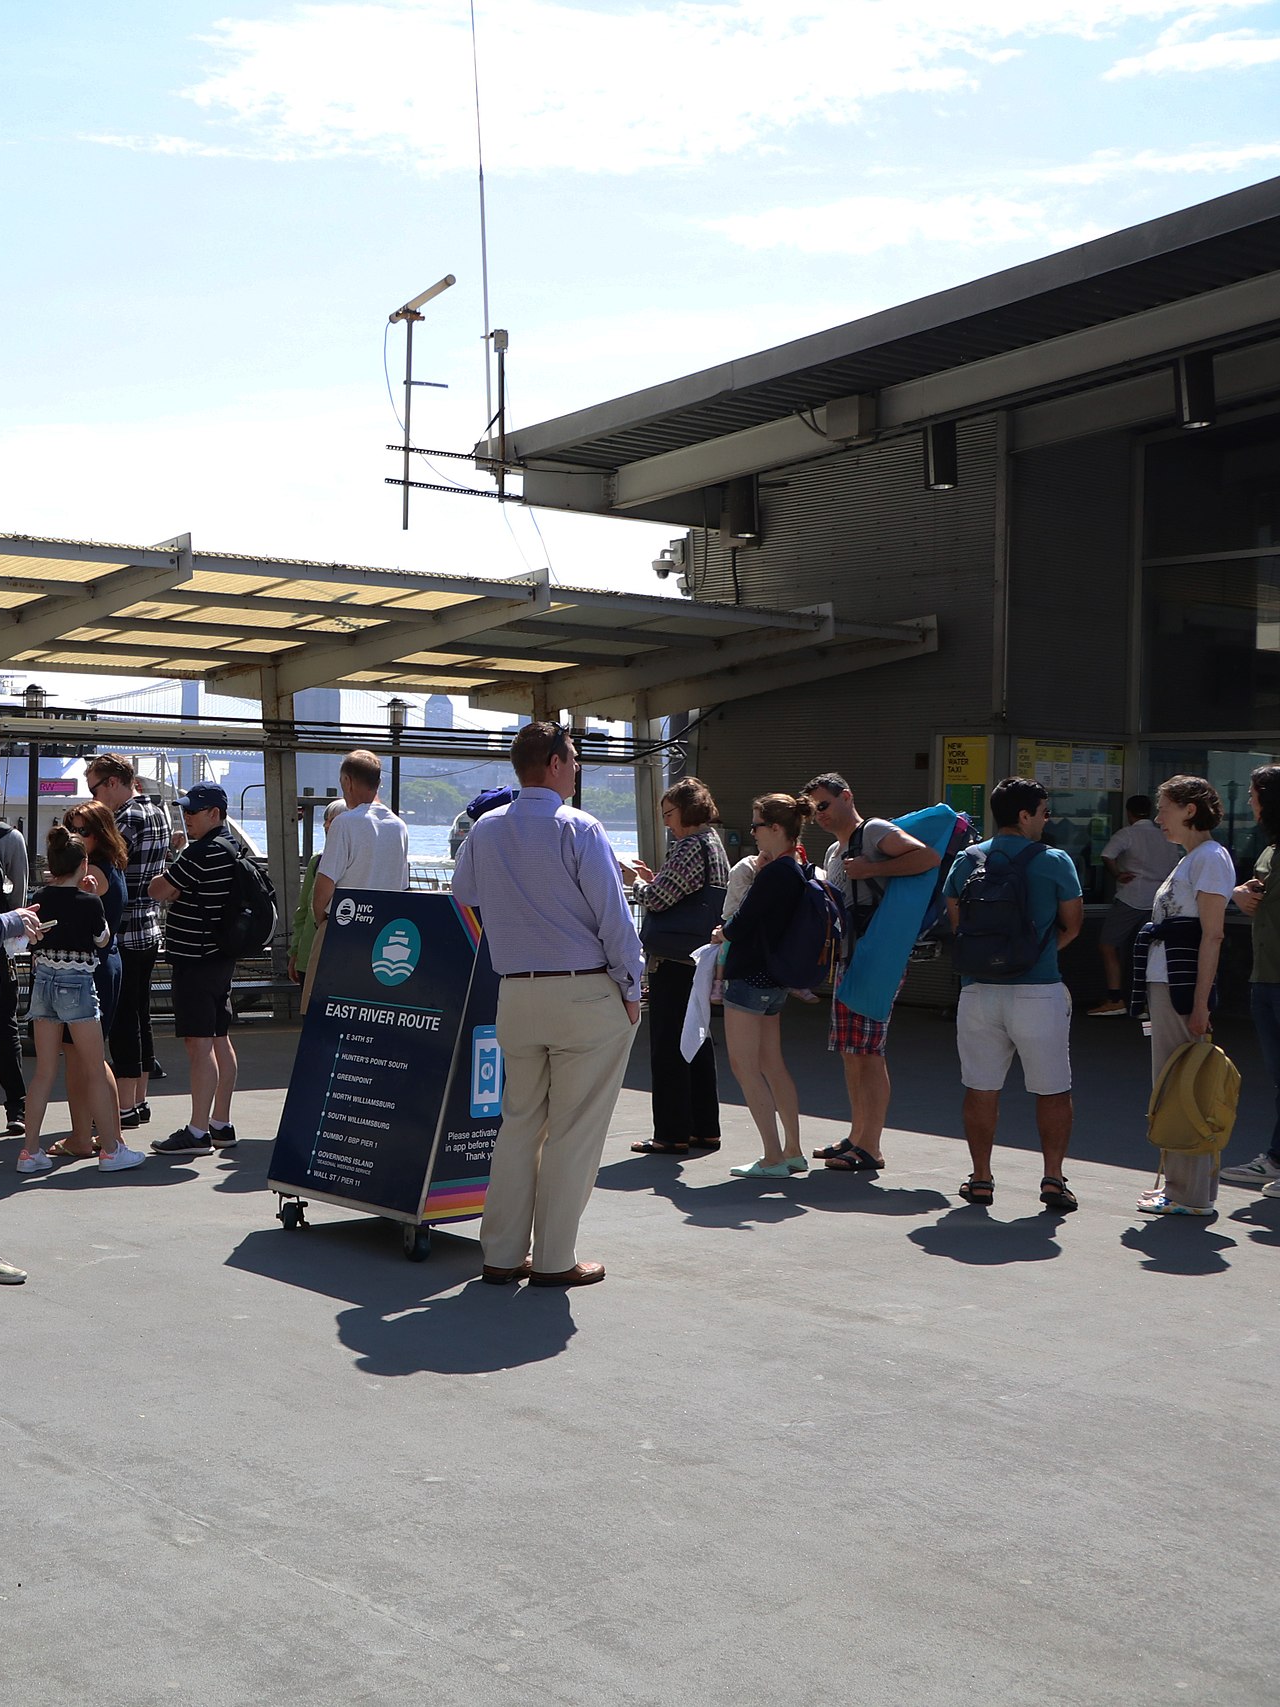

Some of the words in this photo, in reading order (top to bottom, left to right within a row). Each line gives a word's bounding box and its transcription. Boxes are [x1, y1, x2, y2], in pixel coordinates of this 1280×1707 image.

[947, 742, 963, 750] NEW
[947, 750, 966, 758] YORK
[947, 758, 969, 766] WATER
[357, 904, 373, 913] NYC
[355, 913, 375, 925] Ferry
[325, 1003, 357, 1020] EAST
[358, 1008, 395, 1025] RIVER
[397, 1013, 441, 1031] ROUTE
[351, 1034, 366, 1043] 34TH
[365, 1036, 374, 1044] ST
[341, 1053, 370, 1064] HUNTER'S
[370, 1057, 387, 1067] POINT
[388, 1061, 408, 1070] SOUTH
[336, 1073, 373, 1085] GREENPOINT
[332, 1092, 352, 1102] NORTH
[352, 1095, 396, 1110] WILLIAMSBURG
[327, 1111, 347, 1121] SOUTH
[347, 1115, 390, 1130] WILLIAMSBURG
[322, 1131, 344, 1142] DUMBO
[347, 1136, 360, 1145] BBP
[360, 1139, 373, 1148] PIER
[448, 1131, 470, 1140] Please
[471, 1128, 498, 1138] activate
[445, 1144, 452, 1152] in
[453, 1144, 466, 1153] app
[467, 1140, 489, 1150] before
[317, 1150, 352, 1164] GOVERNORS
[352, 1158, 374, 1169] ISLAND
[465, 1151, 487, 1161] Thank
[336, 1163, 355, 1172] WEEKEND
[355, 1167, 371, 1175] SERVICE
[313, 1170, 328, 1180] WALL
[328, 1173, 337, 1181] ST
[340, 1176, 354, 1185] PIER
